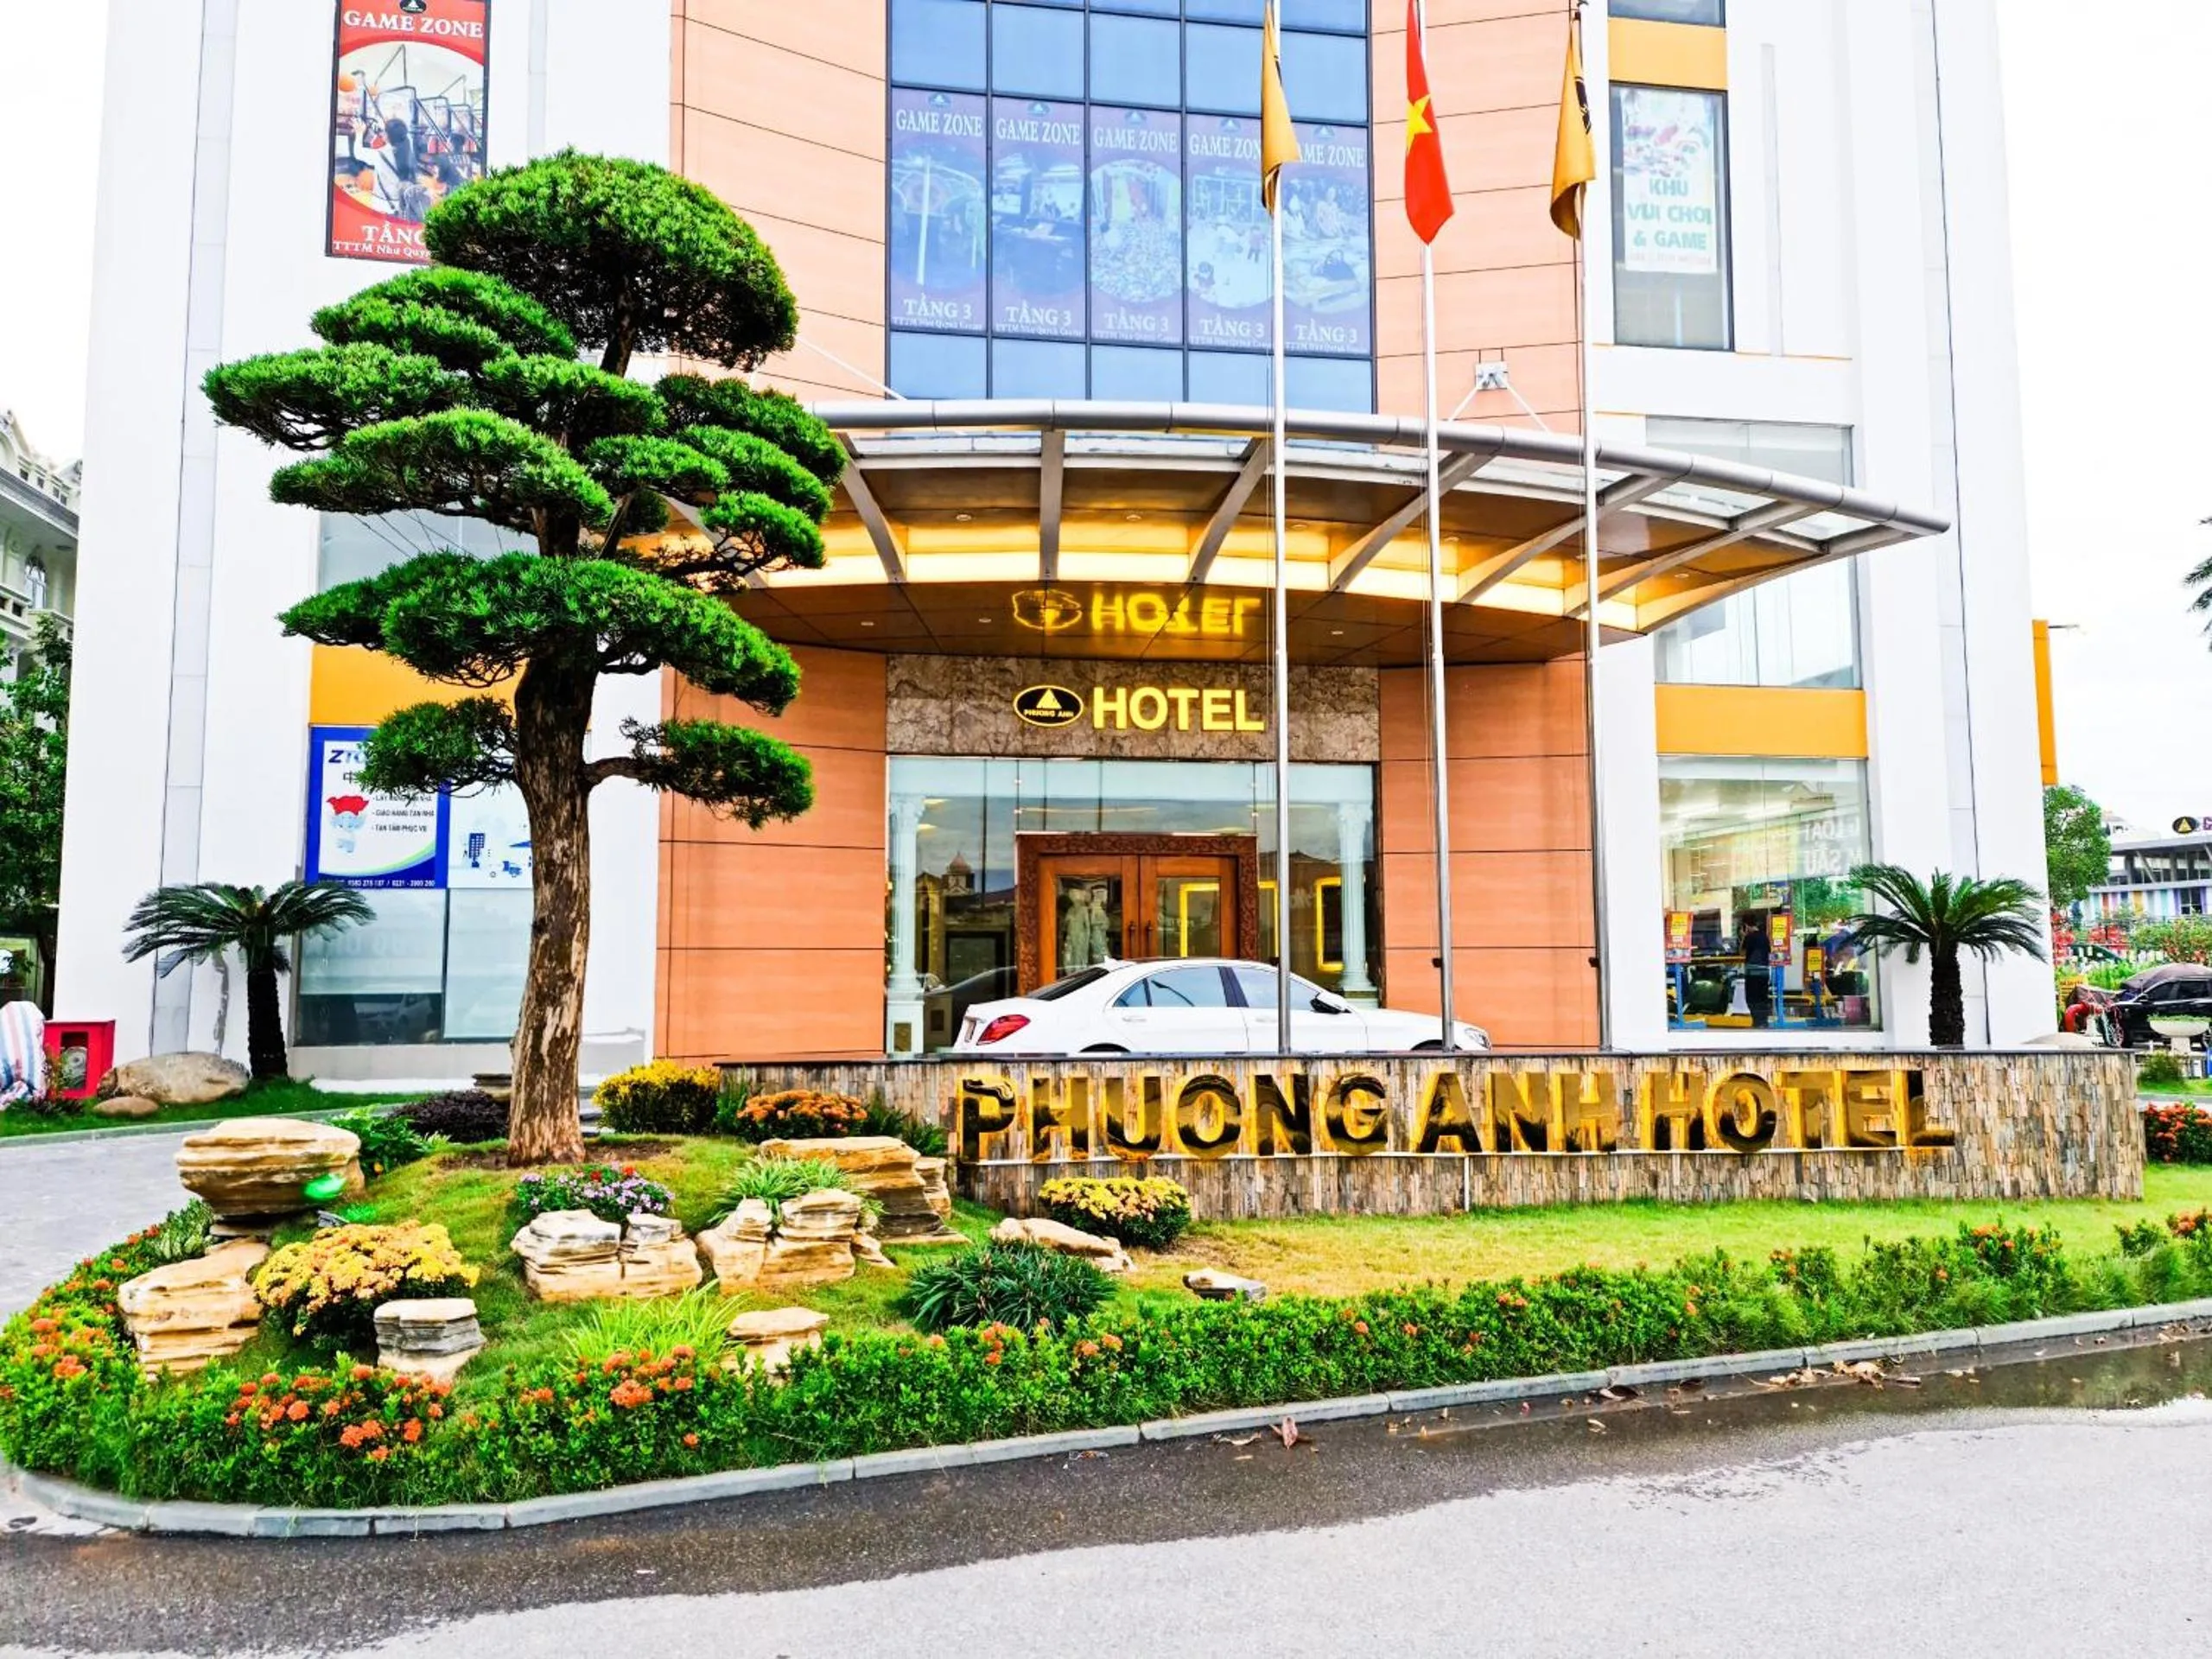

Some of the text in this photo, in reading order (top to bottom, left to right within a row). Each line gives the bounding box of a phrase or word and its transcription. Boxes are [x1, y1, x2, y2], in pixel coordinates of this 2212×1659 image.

[343, 10, 484, 39] GAME ZONE
[896, 109, 983, 137] GAME ZONE
[996, 118, 1080, 146] GAME ZONE
[1094, 126, 1178, 154] GAME ZONE
[1189, 133, 1262, 160] GAME ZON
[1328, 144, 1366, 168] ZONE
[334, 241, 372, 254] TTTM
[1654, 230, 1707, 251] GAME
[963, 303, 973, 321] 3
[1062, 310, 1072, 327] 3
[1160, 316, 1170, 333] 3
[1255, 322, 1265, 340] 3
[1349, 327, 1358, 344] 3
[1092, 686, 1265, 731] HOTEL
[958, 1068, 1955, 1162] PHUONG ANH HOTEL
